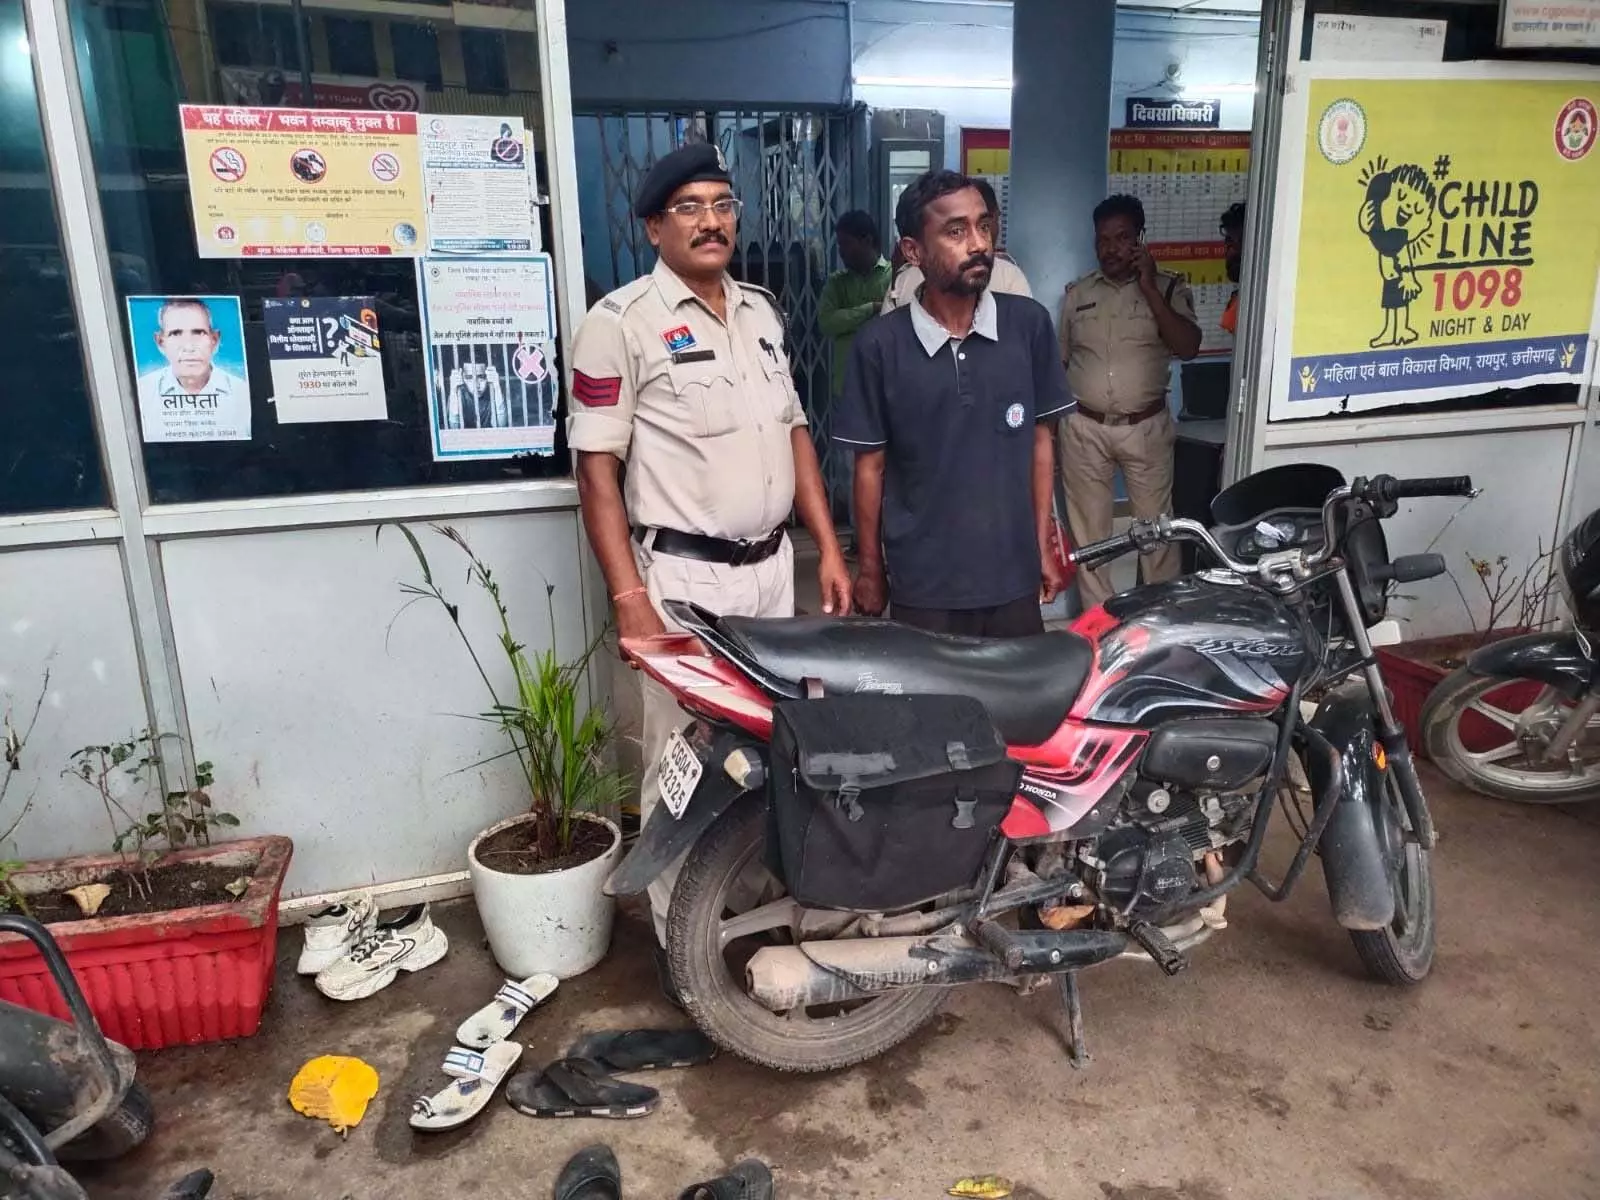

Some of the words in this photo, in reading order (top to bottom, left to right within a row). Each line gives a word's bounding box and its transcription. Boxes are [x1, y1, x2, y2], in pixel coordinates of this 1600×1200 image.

[224, 110, 261, 127] परिसर
[278, 114, 307, 126] भवन
[1132, 103, 1214, 122] दिवसाधिकारी
[1438, 180, 1539, 220] CHILD
[1437, 221, 1532, 260] LINE
[1433, 267, 1523, 312] 1098
[1429, 316, 1476, 338] NIGHT
[1483, 315, 1493, 332] &
[1502, 312, 1531, 331] DAY
[1324, 364, 1357, 383] महिला
[1360, 361, 1376, 378] एवं
[1378, 359, 1399, 377] बाल
[1402, 357, 1437, 375] विकास
[1512, 347, 1556, 368] छत्तीसगढ़
[299, 380, 321, 389] 1930
[161, 393, 219, 409] लापता
